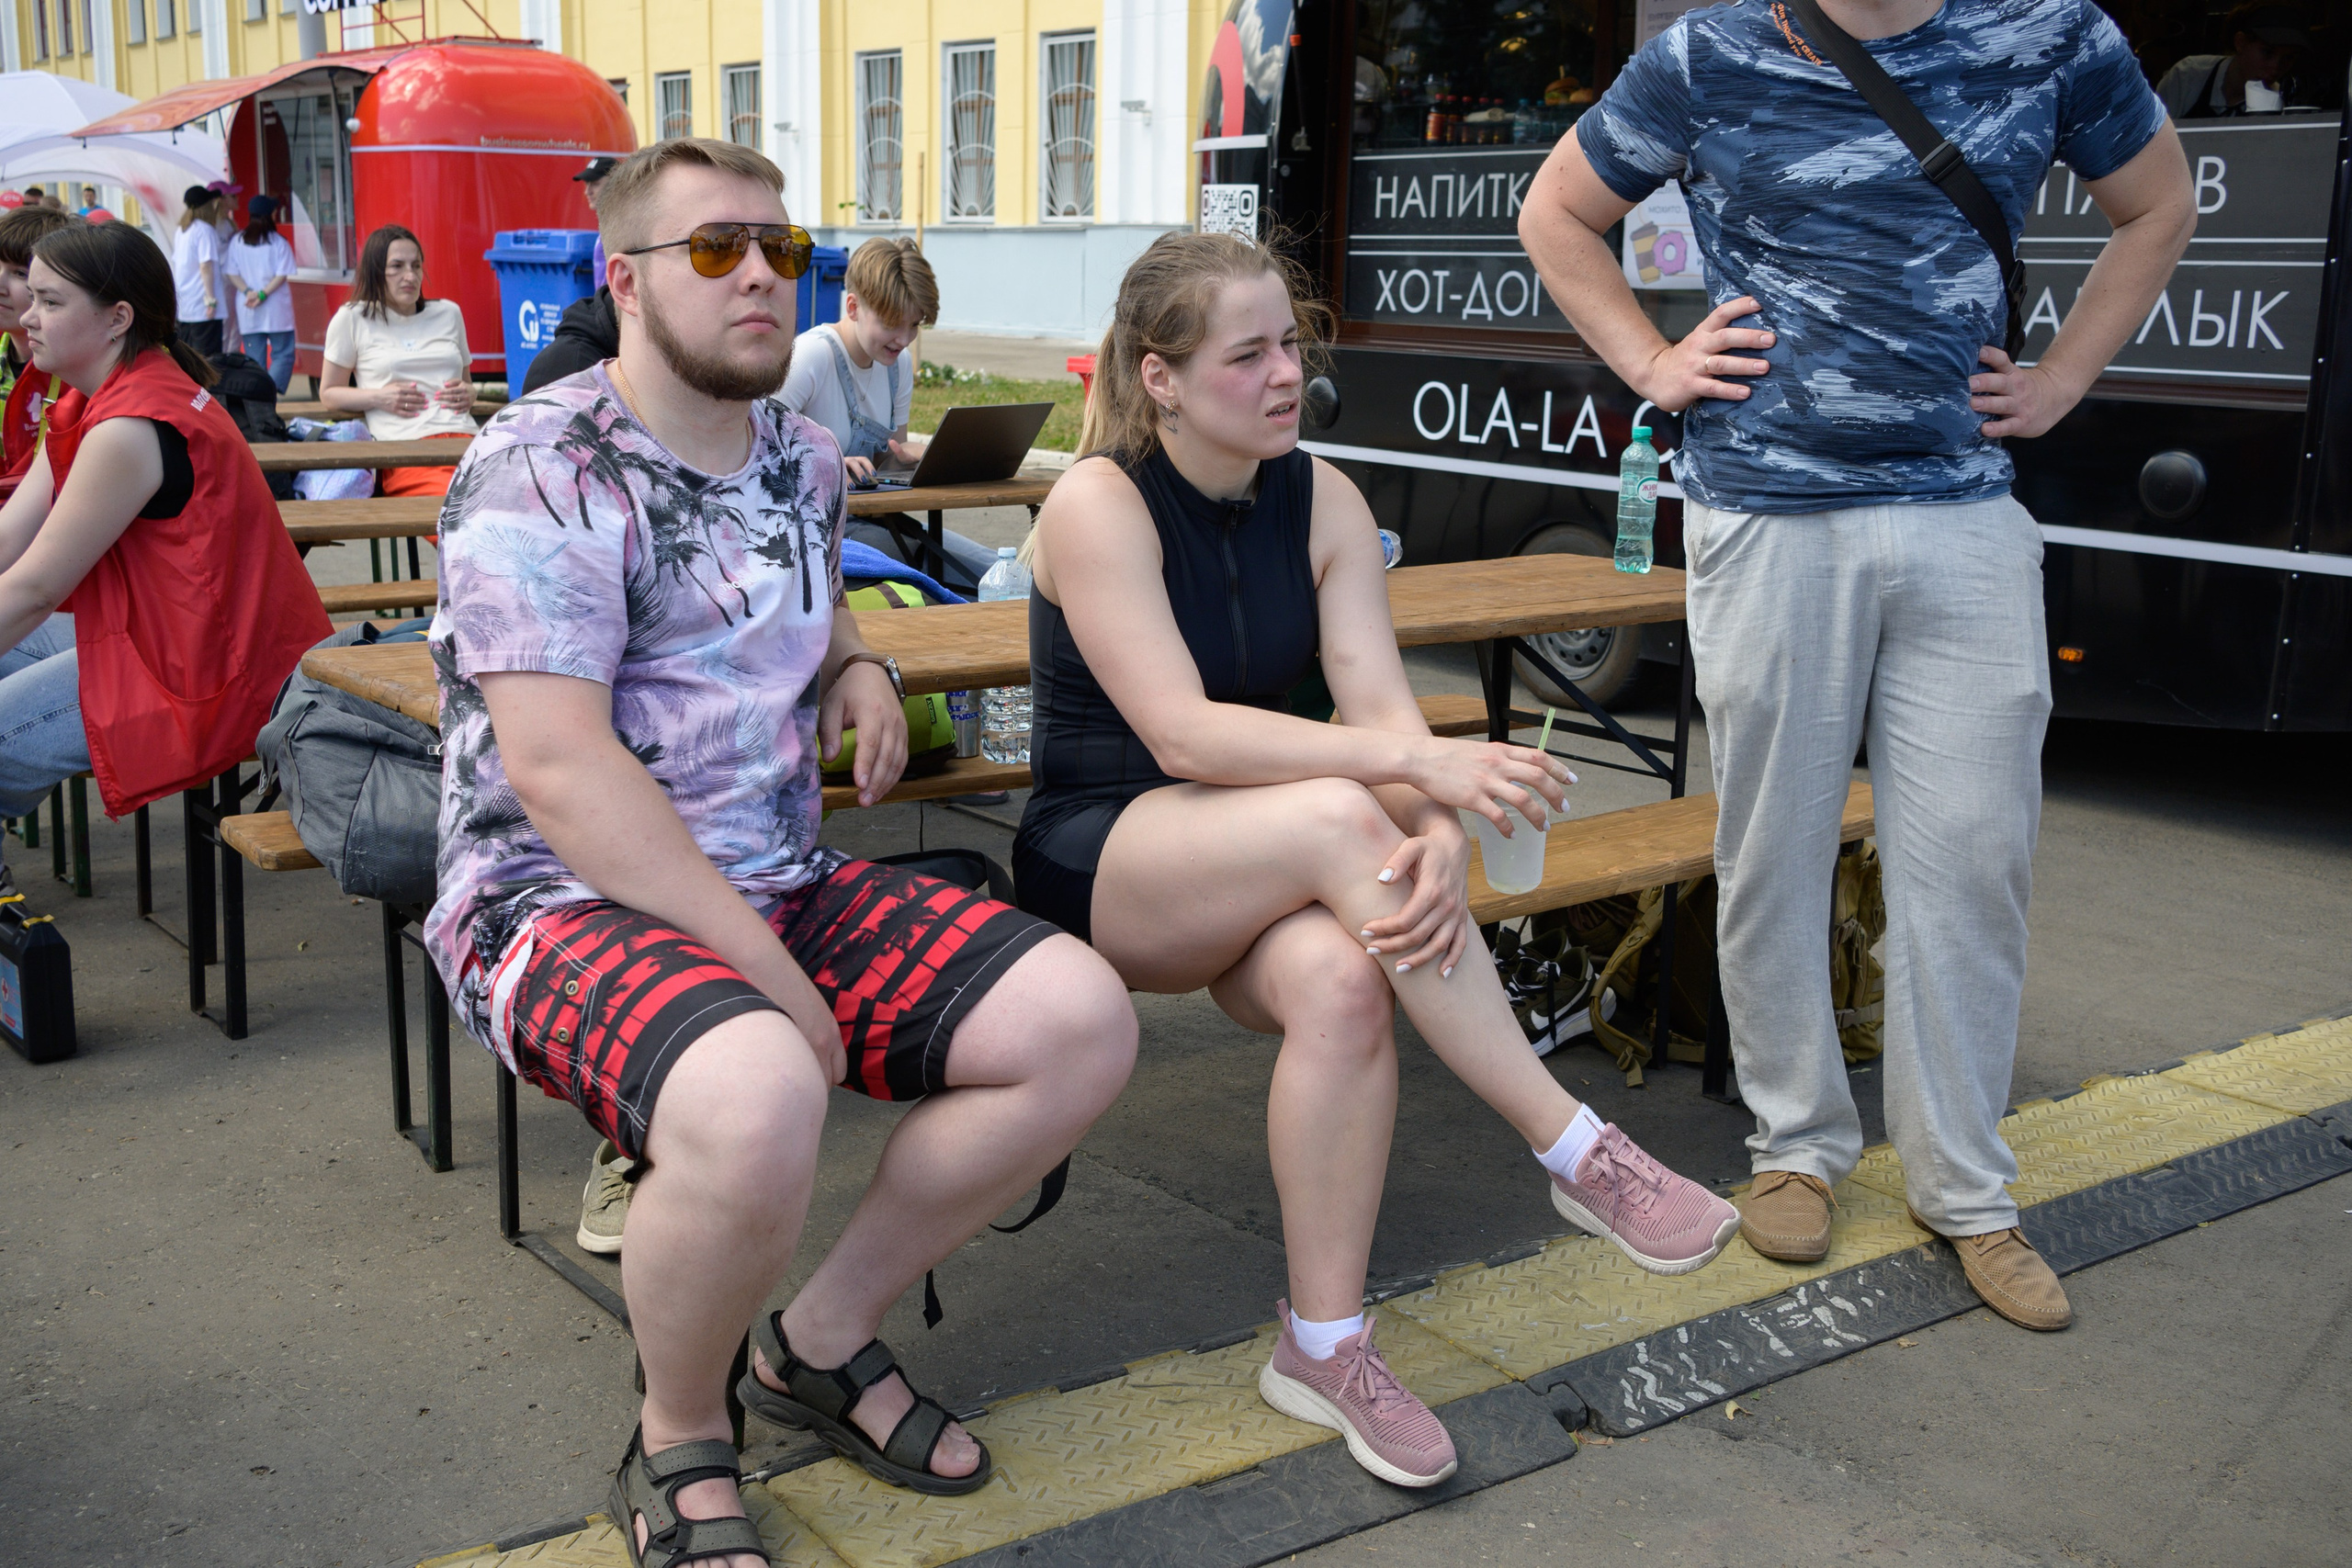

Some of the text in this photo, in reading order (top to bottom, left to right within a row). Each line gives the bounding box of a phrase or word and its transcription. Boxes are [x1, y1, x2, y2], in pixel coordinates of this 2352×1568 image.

[1374, 172, 1532, 219] НАПИТК
[2023, 286, 2290, 350] АЛЫК
[1413, 380, 1608, 458] OLA-LA
